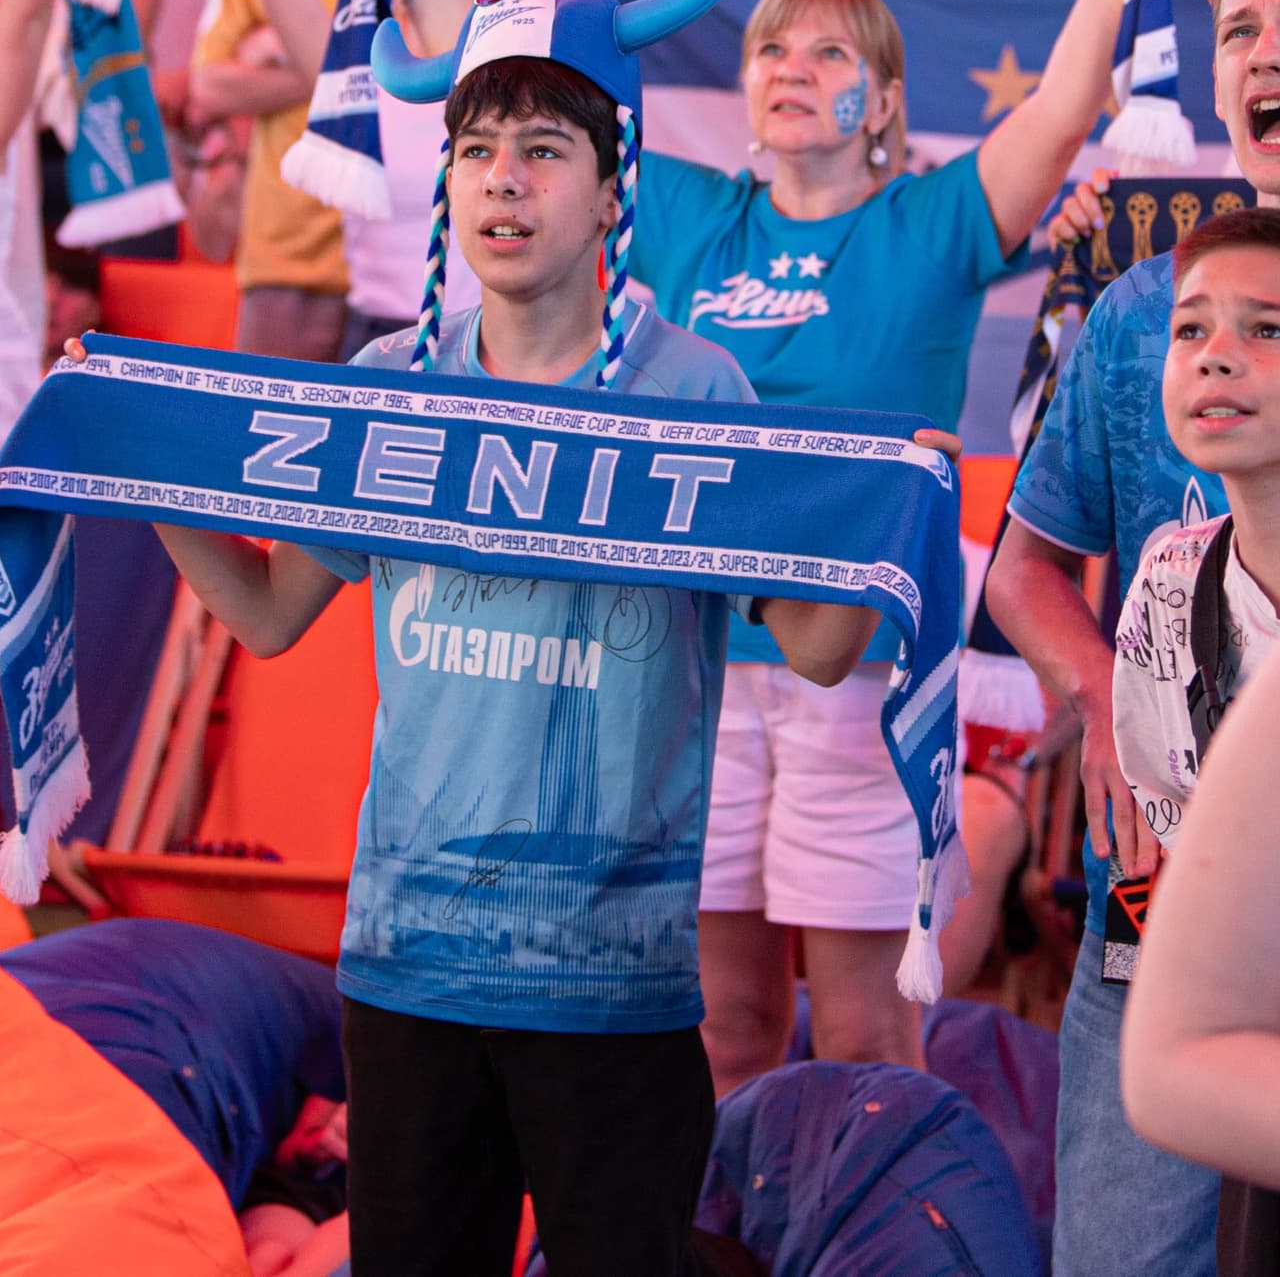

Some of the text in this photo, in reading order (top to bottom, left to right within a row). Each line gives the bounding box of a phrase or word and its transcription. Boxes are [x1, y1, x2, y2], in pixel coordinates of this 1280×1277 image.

[119, 361, 183, 386] CHAMPION
[184, 370, 202, 388] OF
[204, 373, 230, 391] THE
[230, 376, 265, 396] USSR
[300, 384, 352, 406] SEASON
[352, 390, 381, 408] CUP
[423, 396, 478, 417] RUSSIAN
[478, 402, 535, 424] PREMIER
[536, 408, 588, 431] LEAGUE
[587, 414, 618, 434] CUP
[659, 423, 694, 441] UEFA
[694, 426, 725, 443] CUP
[769, 431, 803, 449] UEFA
[804, 434, 873, 455] SUPERCUP
[242, 409, 736, 533] ZENIT
[718, 554, 759, 574] SUPER
[760, 557, 790, 576] CUP
[429, 623, 603, 690] ГАЗПРОМ
